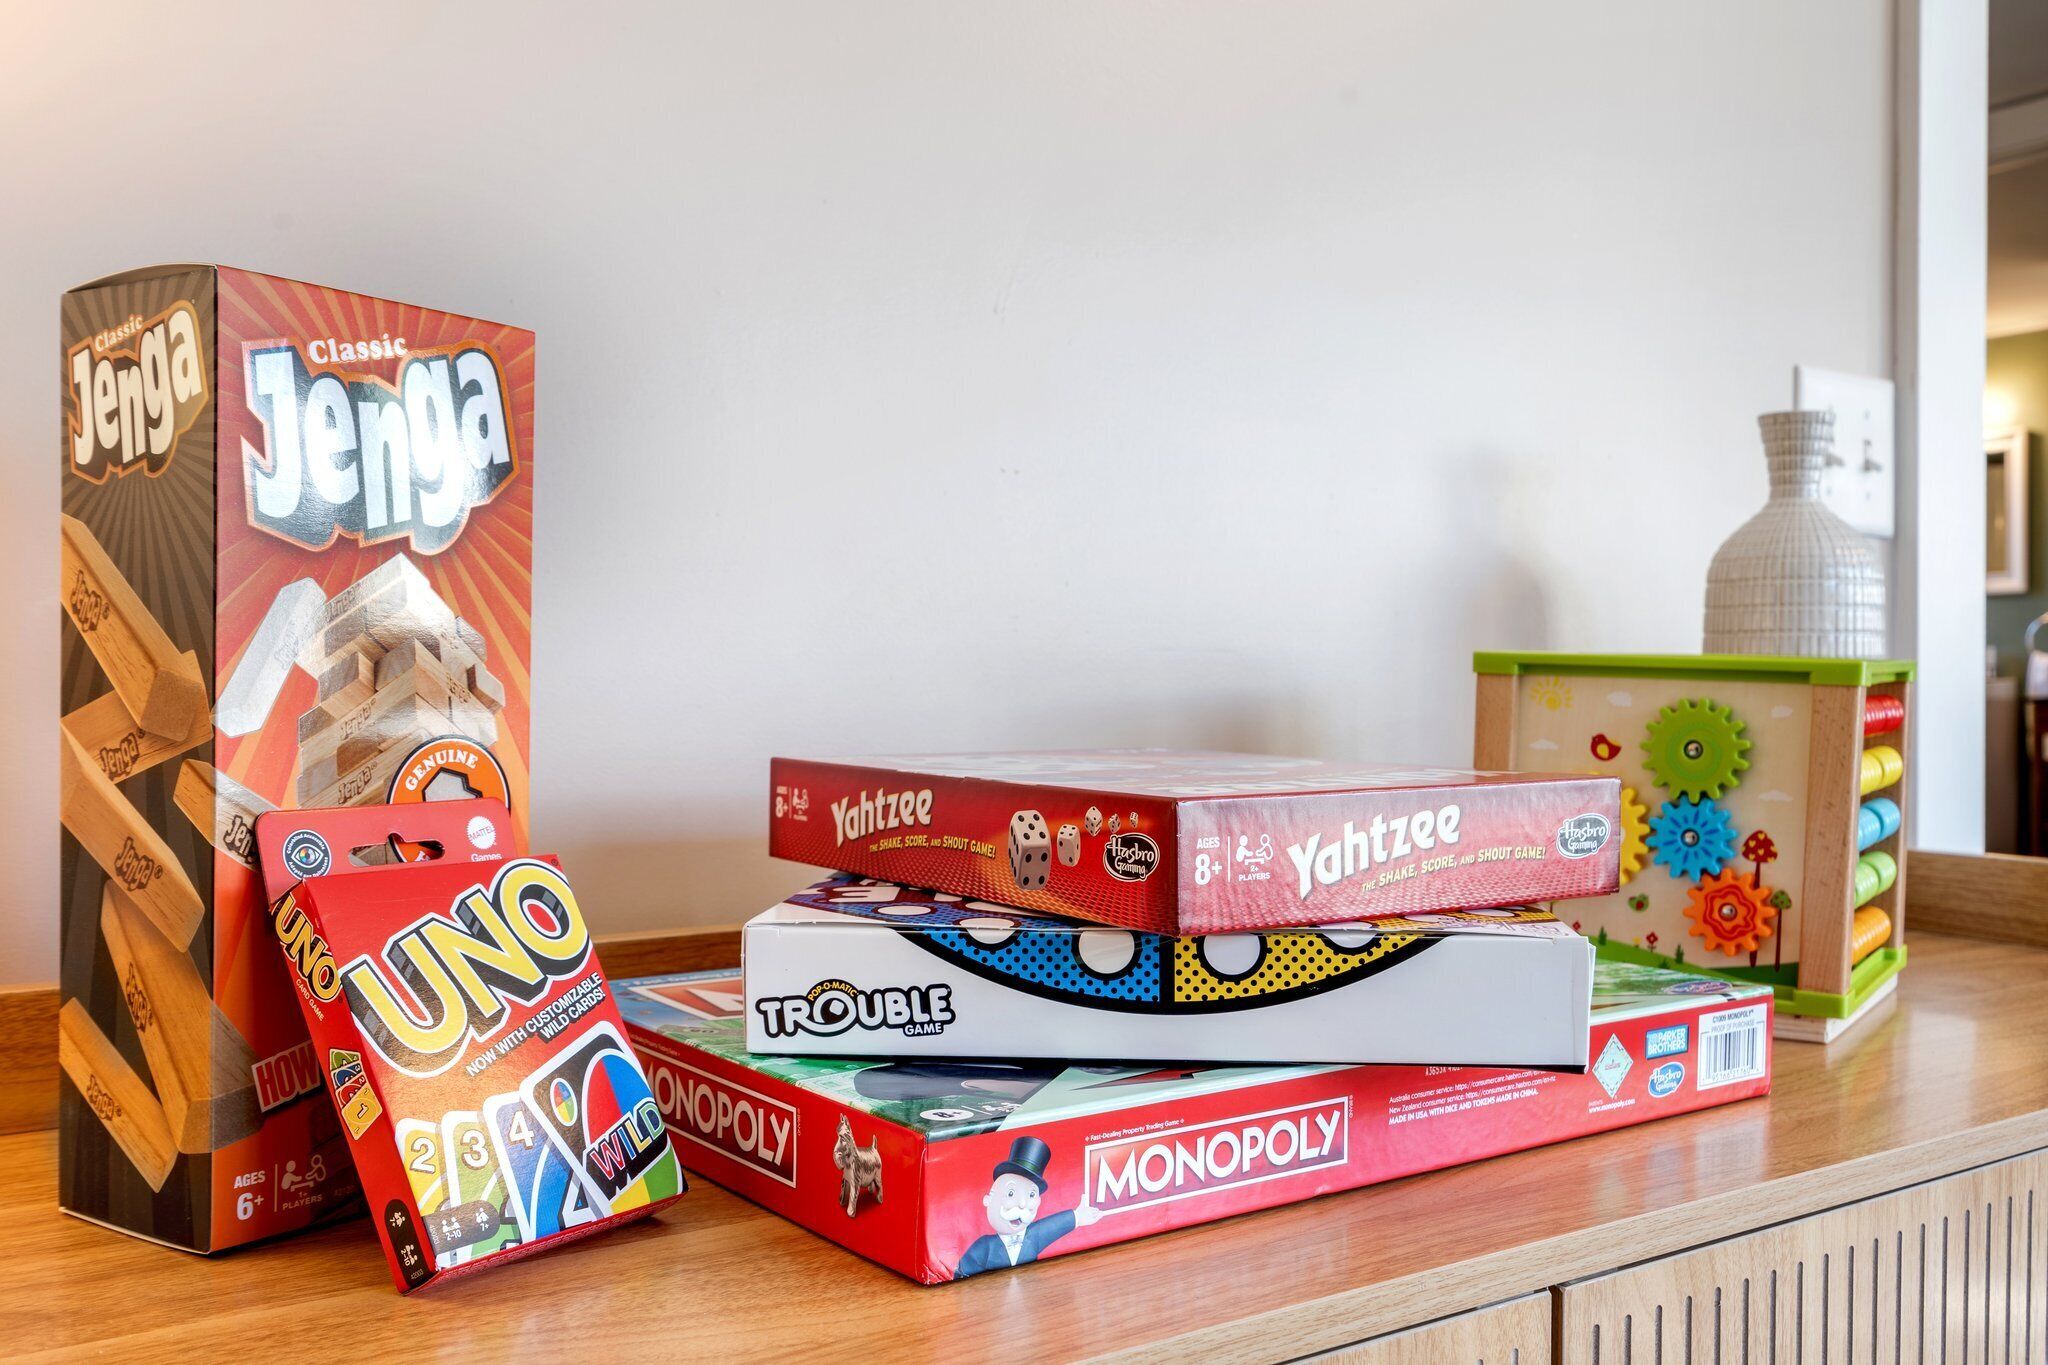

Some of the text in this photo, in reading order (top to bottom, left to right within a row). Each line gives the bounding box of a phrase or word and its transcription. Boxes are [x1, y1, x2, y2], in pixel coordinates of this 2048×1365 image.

[94, 315, 144, 352] Classic
[308, 333, 408, 364] Classic
[73, 310, 202, 465] Jenga
[255, 352, 510, 529] Jenga
[70, 569, 102, 632] Jenga
[100, 732, 139, 781] Jenga
[405, 750, 478, 791] GENUINE
[776, 796, 788, 818] 8+
[831, 787, 933, 848] Yahtzee
[223, 815, 258, 864] Jen
[469, 825, 494, 840] MATTEL
[1196, 837, 1220, 849] AGES
[1560, 820, 1606, 841] Hasbro
[1568, 838, 1597, 853] Gaming
[471, 853, 502, 862] Games
[879, 837, 903, 850] SHAKE,
[905, 835, 929, 848] SCORE,
[930, 838, 941, 847] AND
[942, 835, 969, 850] SHOUT
[970, 840, 996, 858] GAME!
[1107, 837, 1155, 863] Hasbro
[1286, 804, 1460, 900] Yahtzee
[114, 836, 154, 891] Jenga
[1115, 856, 1147, 878] Gaming
[1195, 853, 1222, 885] 8+
[1238, 872, 1271, 881] PLAYERS
[1362, 846, 1546, 893] THE SHAKE, SCORE, AND SHOUT GAME!
[275, 893, 341, 1001] UNO
[348, 866, 589, 1053] UNO
[296, 978, 324, 1022] CARD GAME
[807, 981, 859, 1001] POP-O-MATIC
[466, 1048, 498, 1076] NOW
[495, 1027, 528, 1055] WITH
[525, 972, 603, 1033] CUSTOMIZABLE
[540, 988, 606, 1039] WILD CARDS!
[759, 987, 952, 1034] TROUBLE
[904, 1023, 943, 1036] GAME
[1658, 1028, 1685, 1043] PARKER
[1648, 1039, 1685, 1056] BROTHERS
[256, 1044, 318, 1107] HOW
[1651, 1068, 1681, 1083] Hasbro
[1388, 1094, 1410, 1104] Australia
[1411, 1089, 1435, 1100] consumer
[1435, 1086, 1454, 1096] service:
[1388, 1107, 1401, 1115] New
[1402, 1102, 1422, 1112] Zealand
[1422, 1097, 1446, 1108] consumer
[1388, 1088, 1539, 1125] MADE IN USA WITH DICE AND TOKENS MADE IN CHINA.
[1589, 1098, 1635, 1114] www.monopoly.com
[357, 1103, 369, 1119] 1
[509, 1110, 534, 1150] 4
[590, 1100, 666, 1180] WILD
[1090, 1119, 1179, 1141] Fast-Dealing Property Trading Game
[410, 1137, 436, 1174] 2
[460, 1129, 489, 1170] 3
[1096, 1109, 1341, 1203] MONOPOLY
[233, 1170, 266, 1189] AGES
[236, 1192, 264, 1220] 6+
[282, 1194, 323, 1210] PLAYERS
[445, 1229, 462, 1240] 2-10
[480, 1223, 489, 1232] 7+
